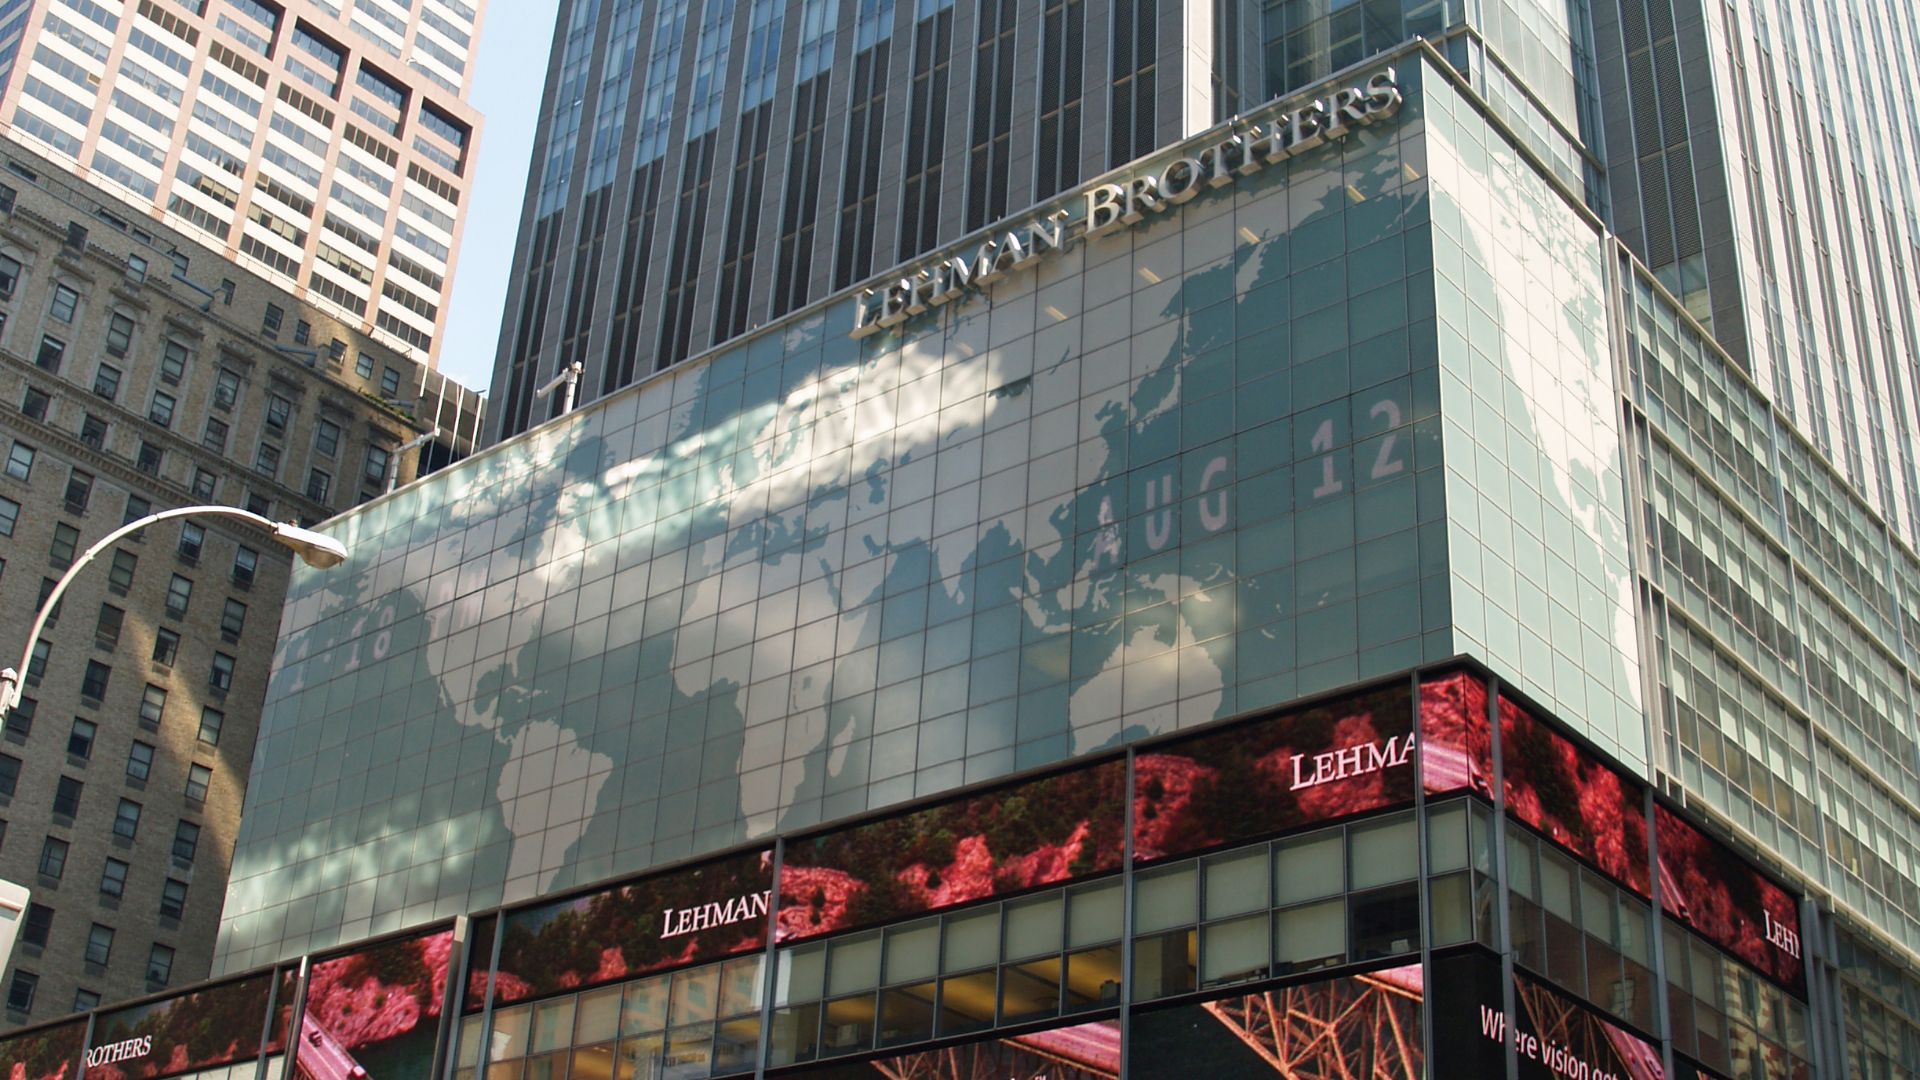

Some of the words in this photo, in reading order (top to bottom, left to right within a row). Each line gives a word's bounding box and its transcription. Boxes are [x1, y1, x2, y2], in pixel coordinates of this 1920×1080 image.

[849, 208, 1069, 339] LEHMAN
[1083, 66, 1402, 236] BROTHERS
[1093, 456, 1228, 573] AUG
[1310, 399, 1403, 499] 12
[1289, 731, 1416, 792] LEHMA
[660, 889, 772, 940] LEHMAN
[1541, 1039, 1589, 1080] vision
